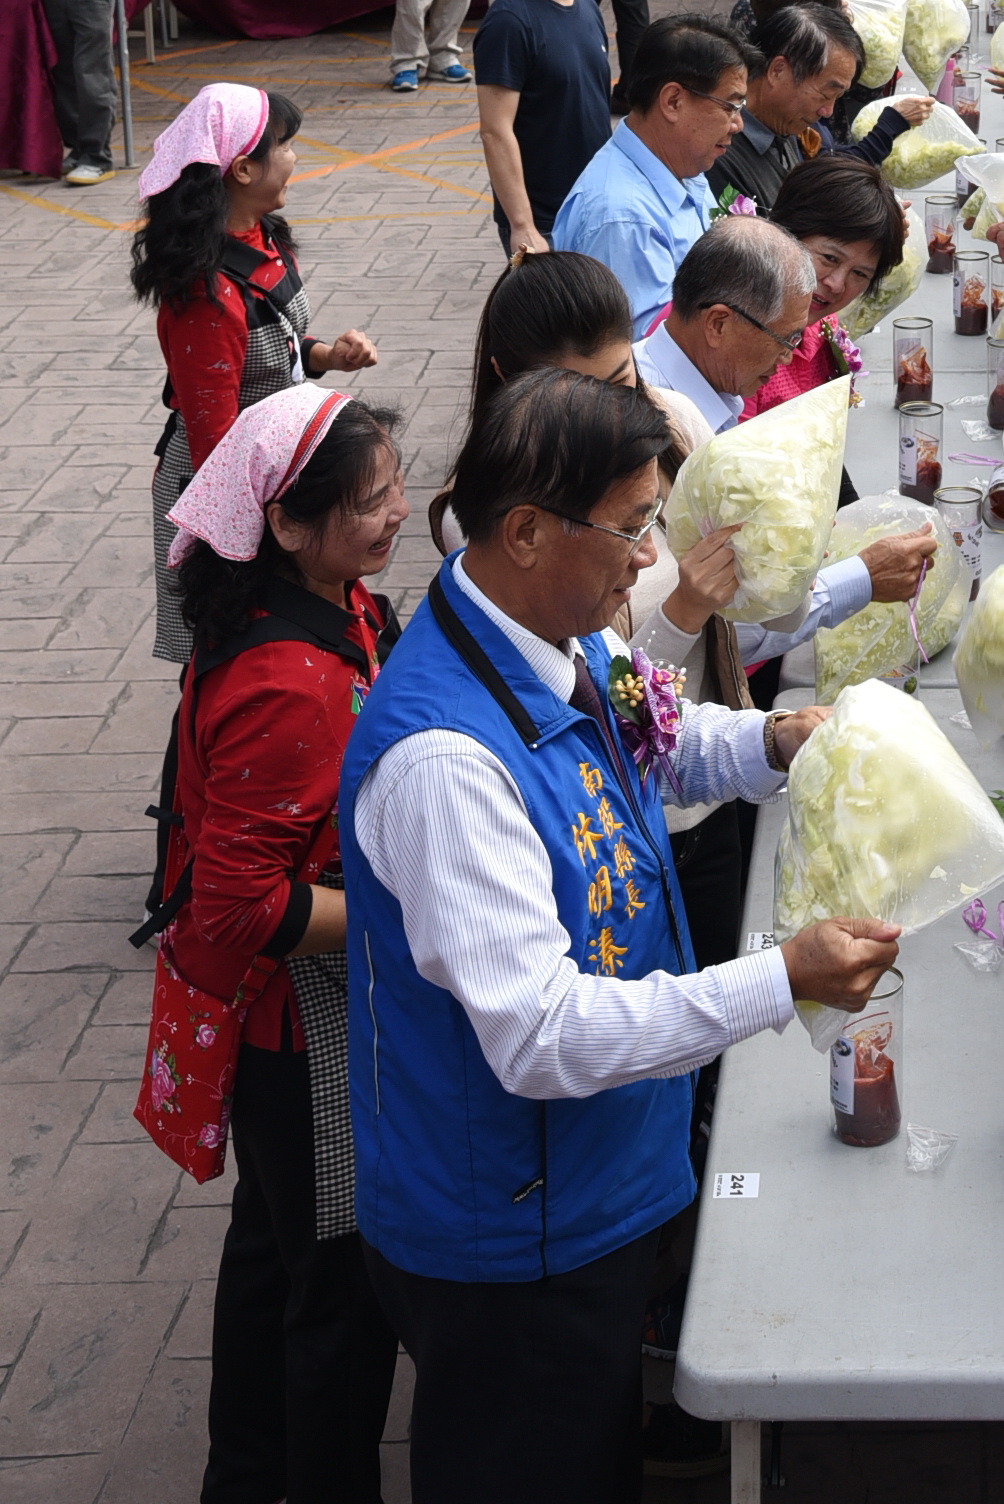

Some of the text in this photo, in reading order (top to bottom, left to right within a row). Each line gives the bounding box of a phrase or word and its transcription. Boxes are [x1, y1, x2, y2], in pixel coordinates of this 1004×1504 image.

[578, 762, 646, 920] 南投縣長
[761, 933, 774, 950] 243
[729, 1174, 745, 1195] 241
